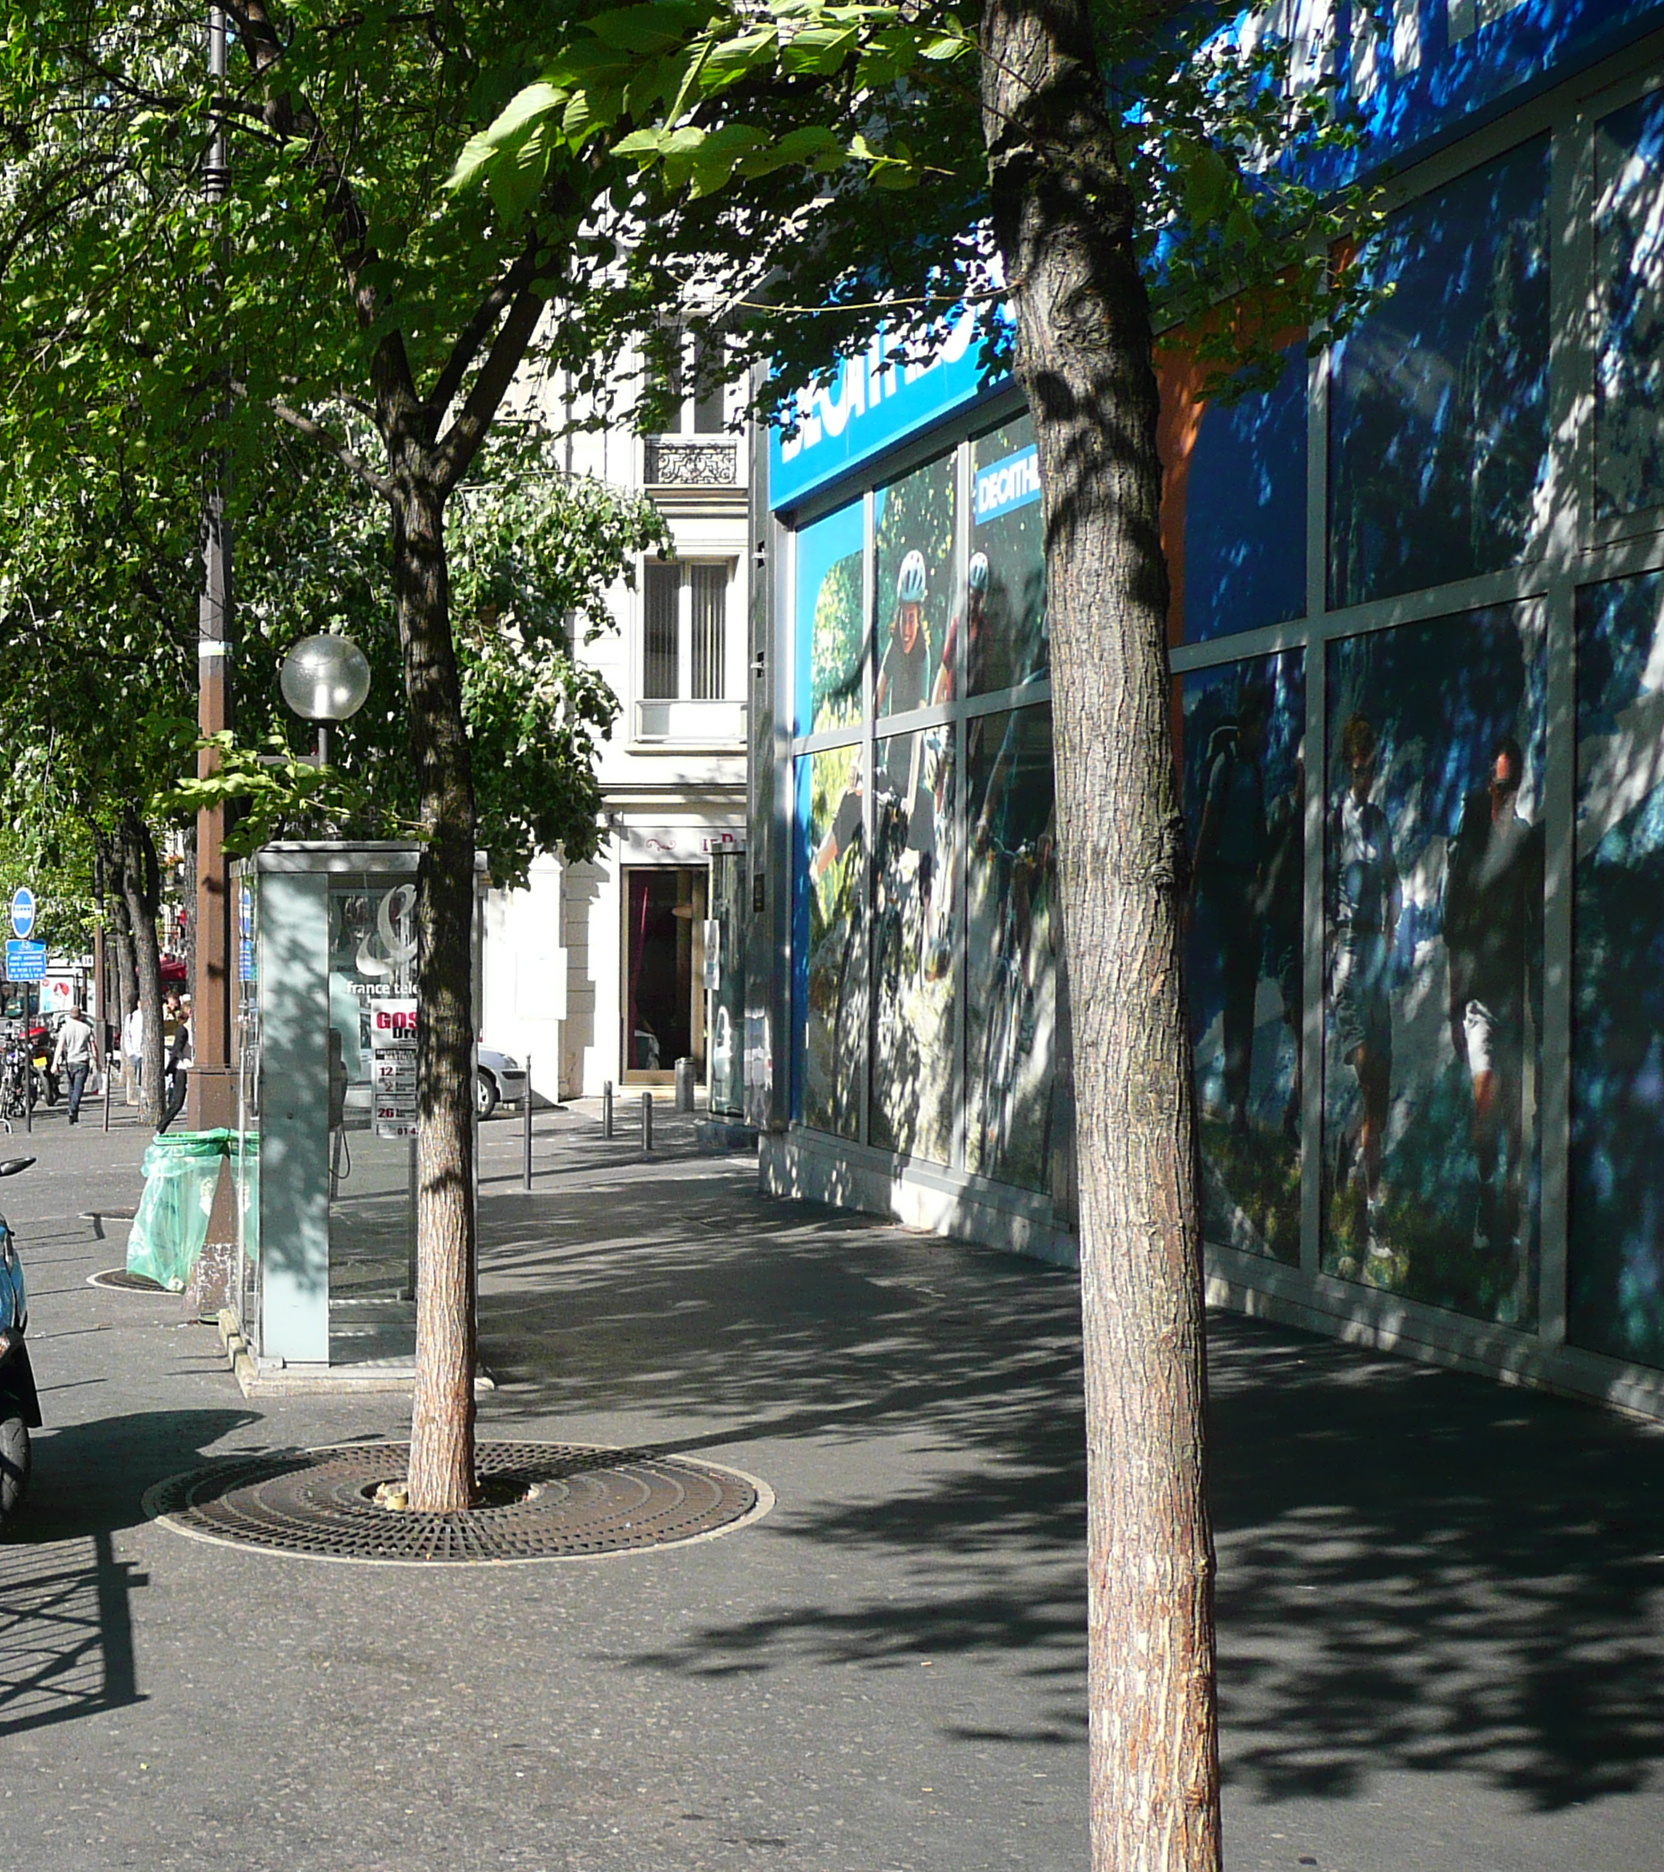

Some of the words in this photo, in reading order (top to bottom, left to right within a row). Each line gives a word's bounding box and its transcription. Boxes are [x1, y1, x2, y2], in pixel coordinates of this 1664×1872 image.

[347, 981, 390, 994] france
[379, 1066, 393, 1077] 12
[378, 1108, 394, 1118] 26
